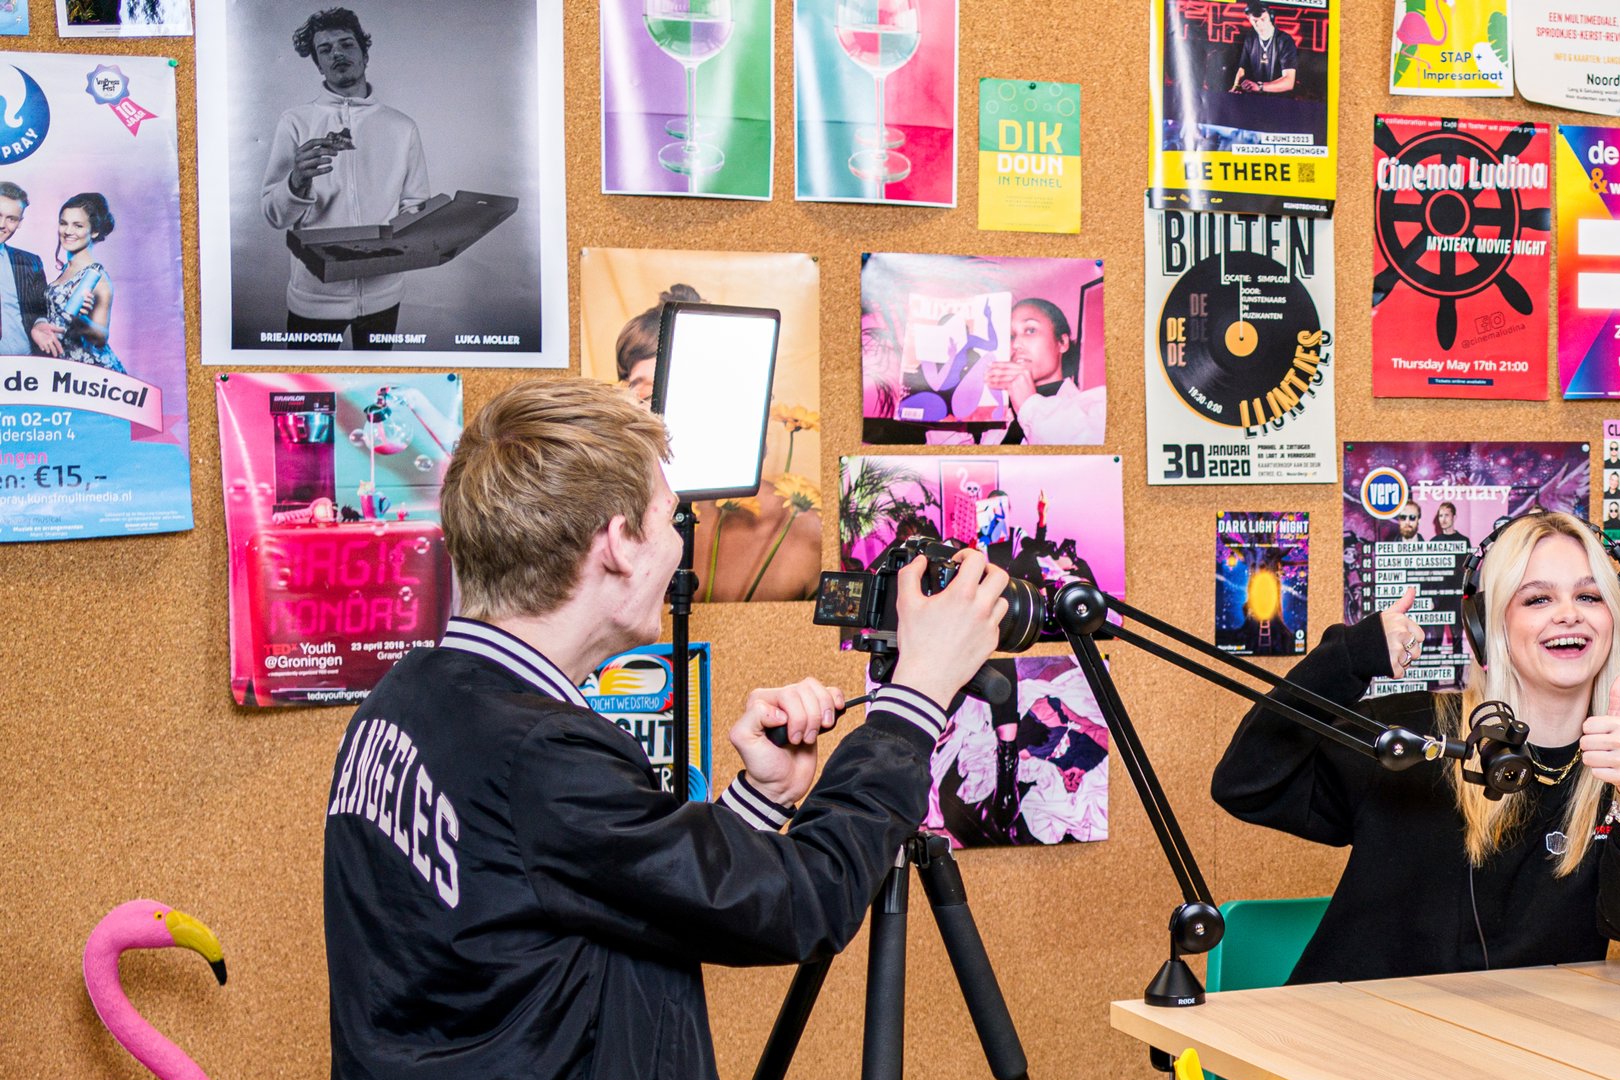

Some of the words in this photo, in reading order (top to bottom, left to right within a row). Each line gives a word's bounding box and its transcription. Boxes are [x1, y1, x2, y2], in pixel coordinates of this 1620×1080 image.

[1548, 12, 1563, 23] EEN
[1440, 51, 1472, 63] STAP
[1423, 68, 1504, 83] Impresariaat
[116, 101, 138, 118] 10
[126, 110, 147, 128] JAAR
[998, 119, 1063, 154] DIK
[1499, 124, 1523, 134] proudly
[1271, 135, 1291, 143] JUNI
[1234, 145, 1272, 154] VRIJDAG
[1278, 147, 1326, 156] GRONINGEN
[1588, 140, 1620, 166] de
[997, 154, 1063, 176] DOUN
[1219, 162, 1292, 182] THERE
[1377, 156, 1465, 191] Cinema
[1469, 154, 1548, 190] Ludina
[998, 176, 1011, 186] IN
[1015, 176, 1063, 188] TUNNEL
[1590, 168, 1608, 194] &
[1426, 236, 1475, 253] MYSTERY
[1476, 238, 1511, 254] MOVIE
[1513, 240, 1547, 256] NIGHT
[1190, 293, 1208, 318] DE
[1166, 317, 1187, 342] DE
[1461, 323, 1526, 349] @cinemaludina
[260, 332, 303, 343] BRIEJAN
[303, 333, 344, 344] POSTMA
[369, 333, 403, 344] DENNIS
[404, 334, 427, 345] SMIT
[455, 335, 481, 345] LUKA
[1166, 342, 1187, 367] DE
[1391, 357, 1444, 373] Thursday
[1446, 359, 1471, 373] May
[1473, 360, 1497, 372] 17th
[1498, 361, 1529, 372] 21:00
[4, 371, 39, 391] de
[52, 371, 149, 408] Musical
[21, 412, 73, 427] 02-07
[66, 429, 76, 441] 4
[1163, 443, 1206, 479] 30
[1208, 444, 1250, 457] JANUARI
[1208, 460, 1252, 478] 2020
[1369, 481, 1400, 506] vera
[1416, 480, 1512, 505] February
[1218, 519, 1247, 534] DARK
[1248, 520, 1278, 534] LIGHT
[1279, 520, 1309, 534] NIGHT
[1362, 544, 1372, 554] 01
[1378, 543, 1396, 553] PEEL
[1397, 543, 1424, 553] DREAM
[1426, 541, 1465, 552] MAGAZINE
[1362, 558, 1372, 568] 02
[1377, 558, 1402, 568] CLASH
[1404, 557, 1414, 567] OF
[1416, 556, 1453, 567] CLASSICS
[1377, 572, 1404, 581] PAUW!
[1362, 587, 1371, 597] 10
[1363, 601, 1371, 611] 11
[1415, 613, 1453, 623] YARDSALE
[300, 641, 336, 655] Youth
[351, 642, 363, 651] 23
[363, 640, 383, 651] april
[265, 655, 343, 670] @Groningen
[377, 651, 403, 660] Grand
[1376, 683, 1398, 694] HANG
[1400, 682, 1424, 692] YOUTH
[329, 718, 460, 909] ANGELES
